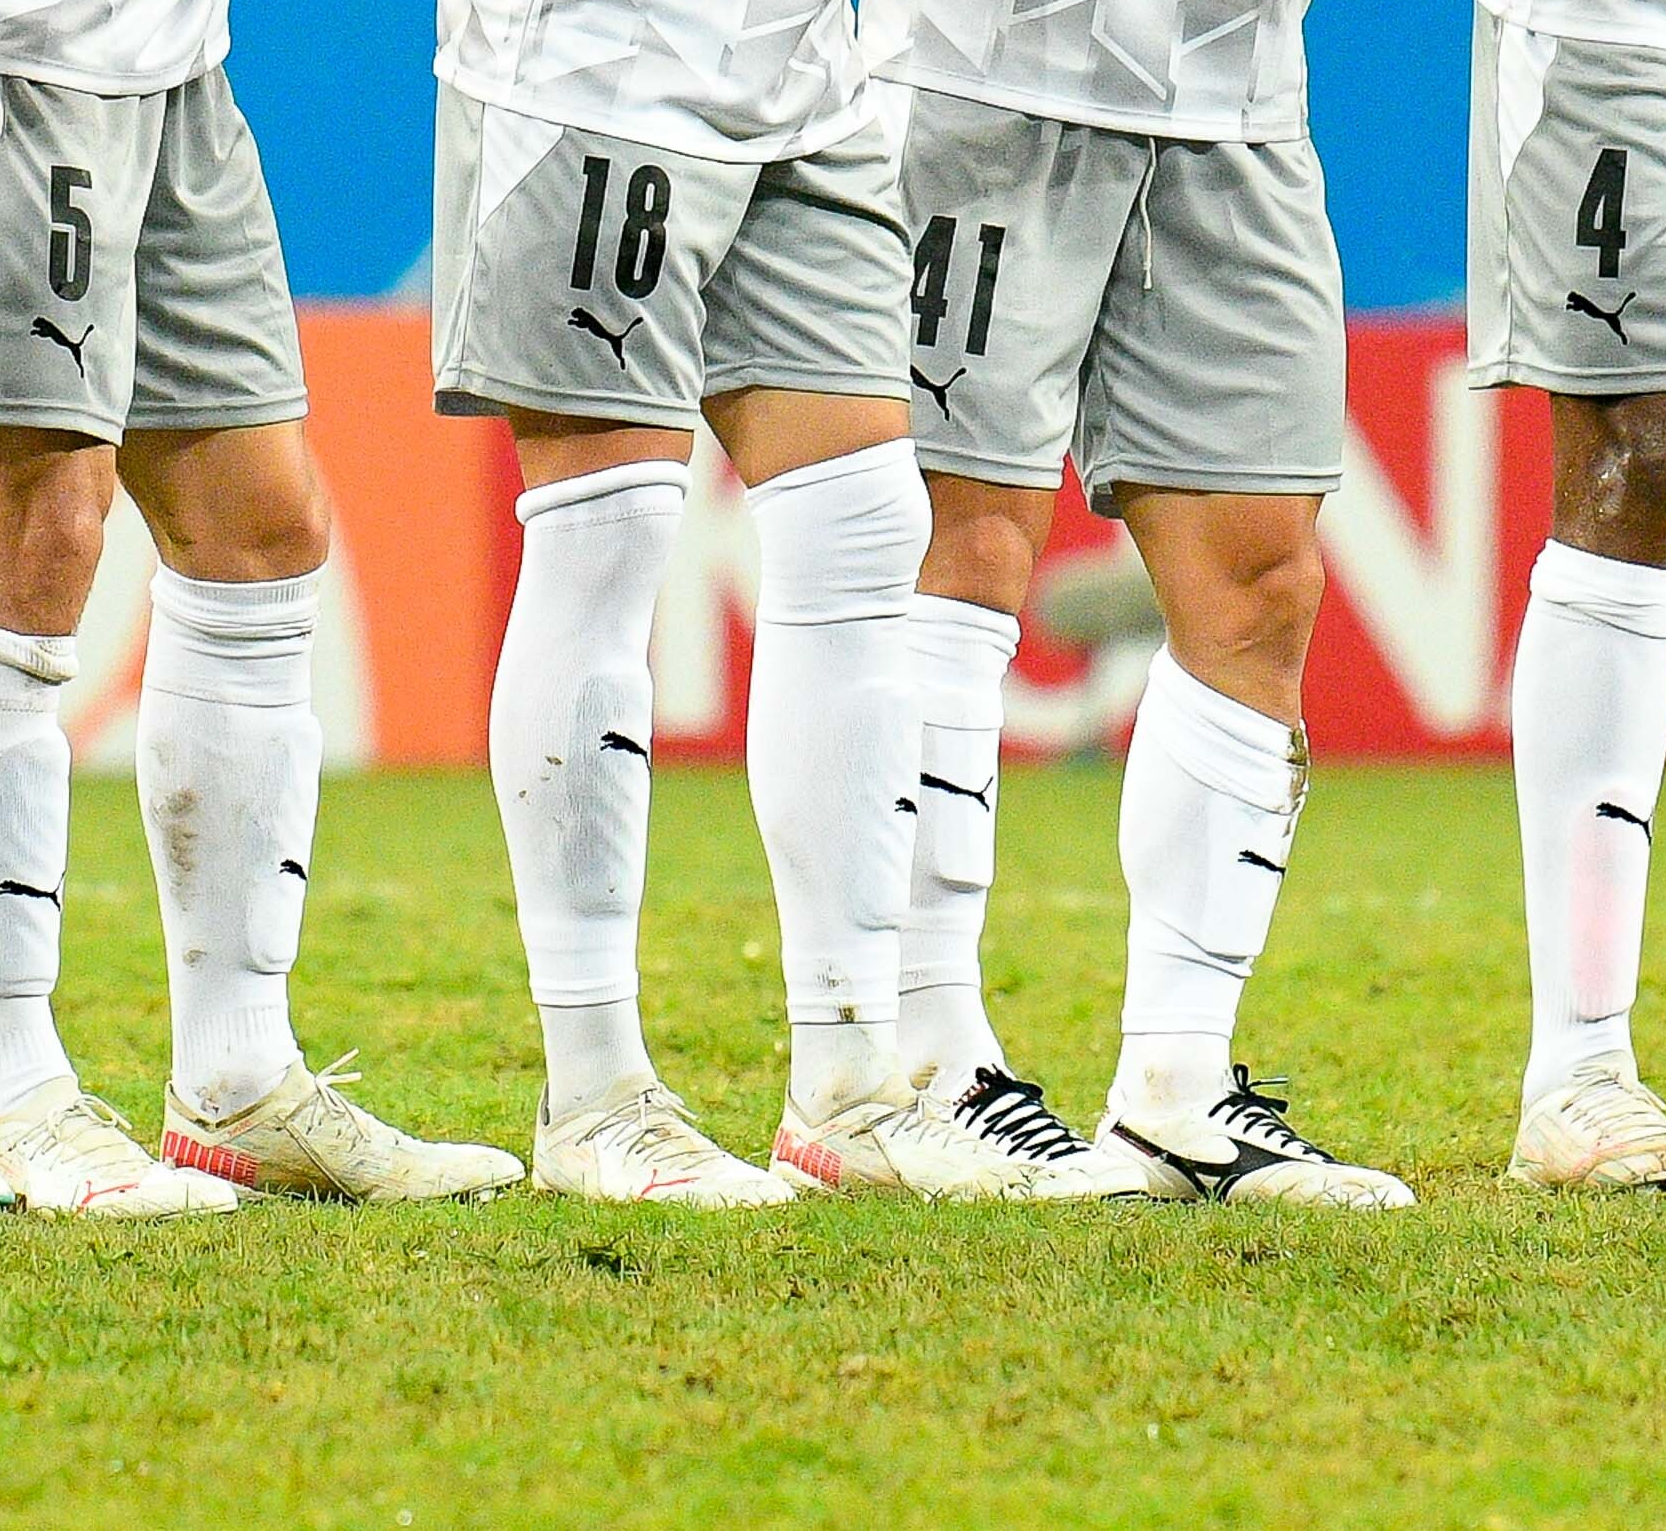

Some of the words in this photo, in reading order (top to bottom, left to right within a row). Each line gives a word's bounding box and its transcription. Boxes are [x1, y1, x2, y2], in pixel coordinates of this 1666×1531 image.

[49, 165, 93, 301] 5
[570, 155, 671, 299] 18
[1576, 148, 1628, 278] 4
[910, 215, 1006, 356] 41
